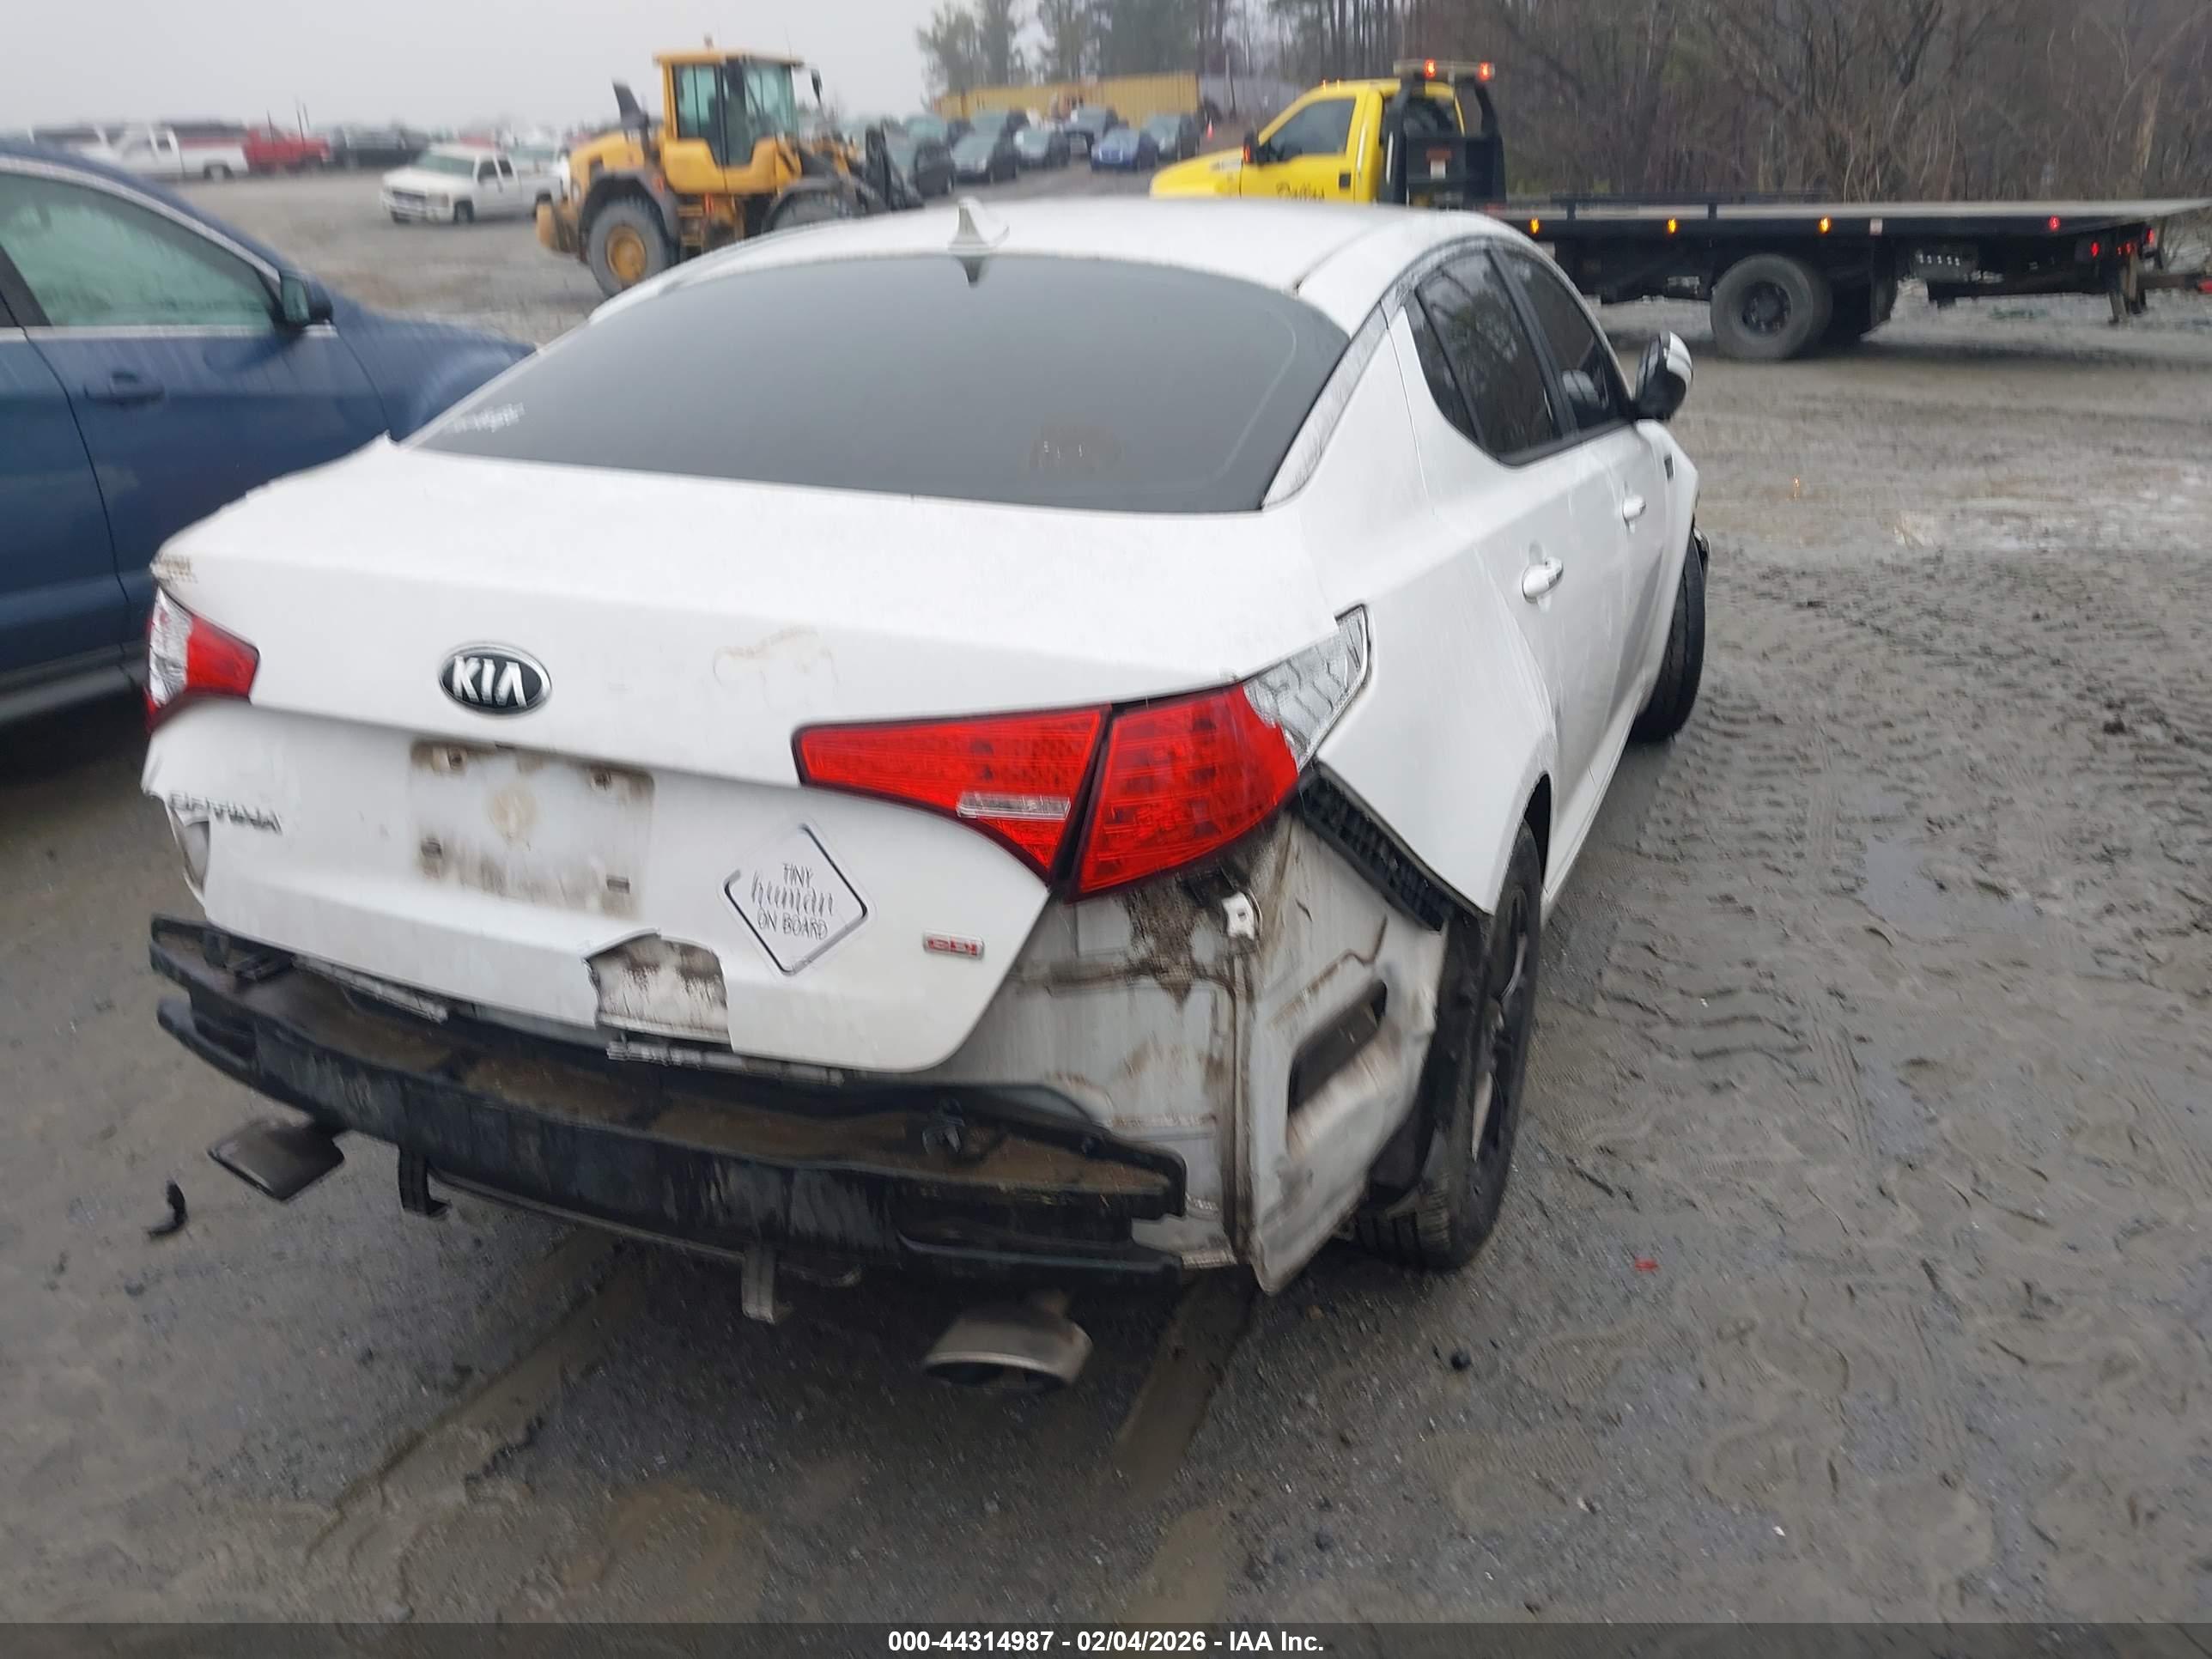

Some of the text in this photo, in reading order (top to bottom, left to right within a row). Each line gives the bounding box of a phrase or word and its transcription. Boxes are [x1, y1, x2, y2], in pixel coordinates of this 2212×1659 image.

[452, 655, 528, 708] KIA
[751, 870, 834, 917] human
[782, 862, 814, 889] TINY
[757, 907, 829, 941] ON BOARD
